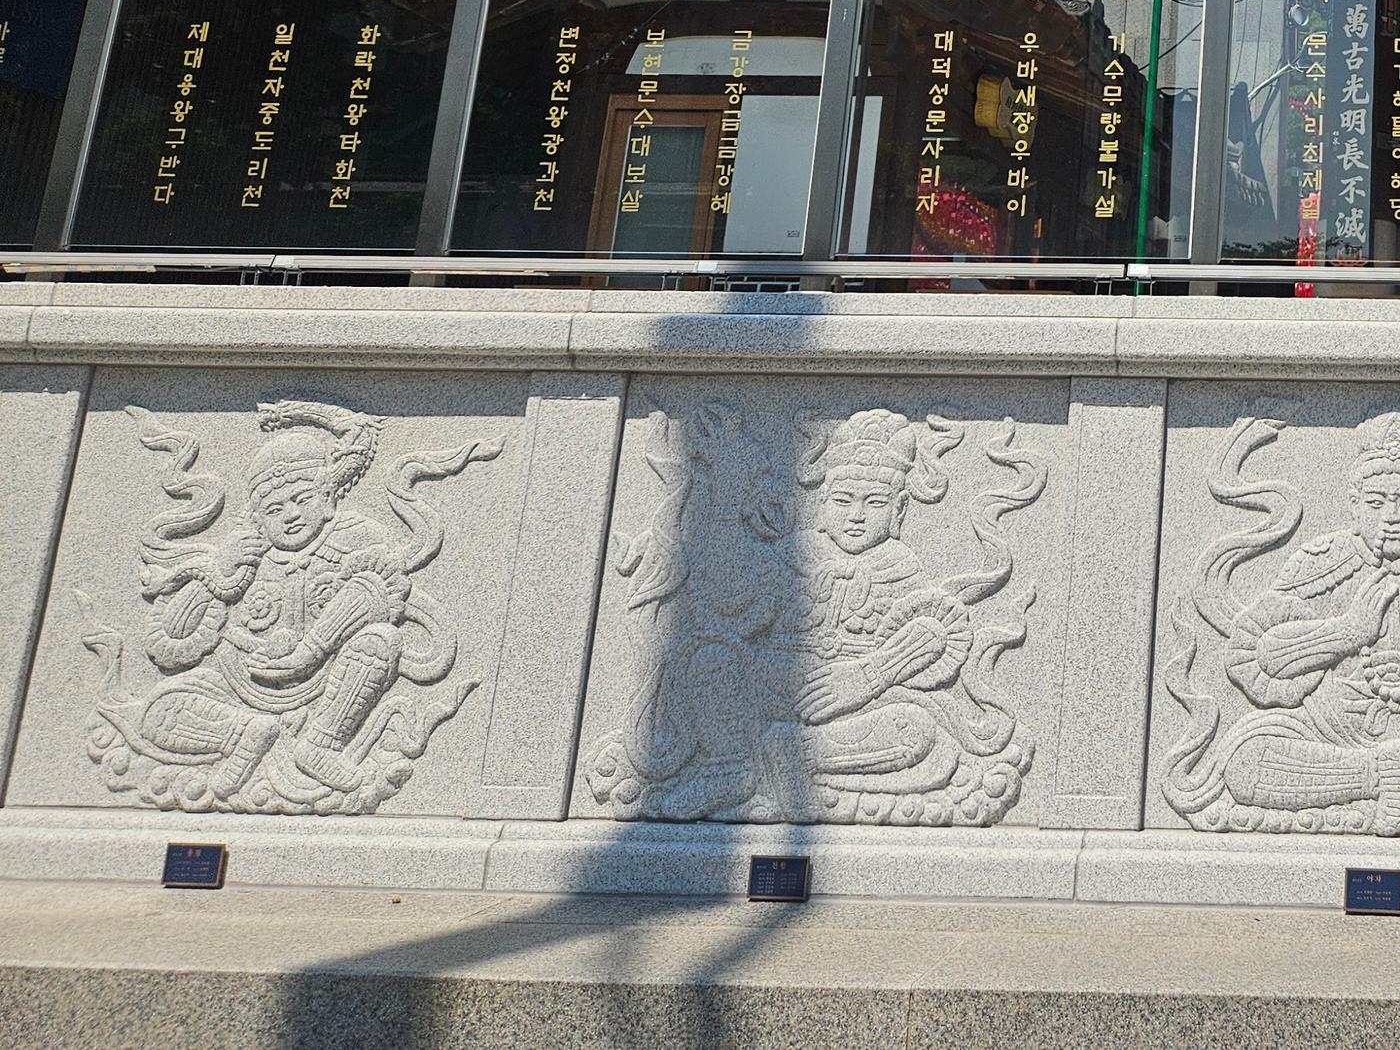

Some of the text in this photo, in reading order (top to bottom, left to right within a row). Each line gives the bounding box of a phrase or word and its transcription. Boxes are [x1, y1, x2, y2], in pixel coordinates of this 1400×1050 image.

[154, 22, 209, 204] 제대용왕구반다
[241, 23, 295, 208] 일천자중도리천
[329, 25, 381, 209] 화락천왕타화천
[534, 26, 580, 212] 변정천왕광과천
[621, 30, 665, 213] 보현문수대보살
[711, 31, 753, 214] 금강장급금강혜
[916, 31, 954, 215] 대덕성문사리자
[1007, 32, 1040, 217] 우바새장우바이
[1094, 33, 1127, 218] 기수무량불가설
[1301, 34, 1327, 220] 문수사리최제일
[1335, 3, 1370, 243] 萬古光明長不滅
